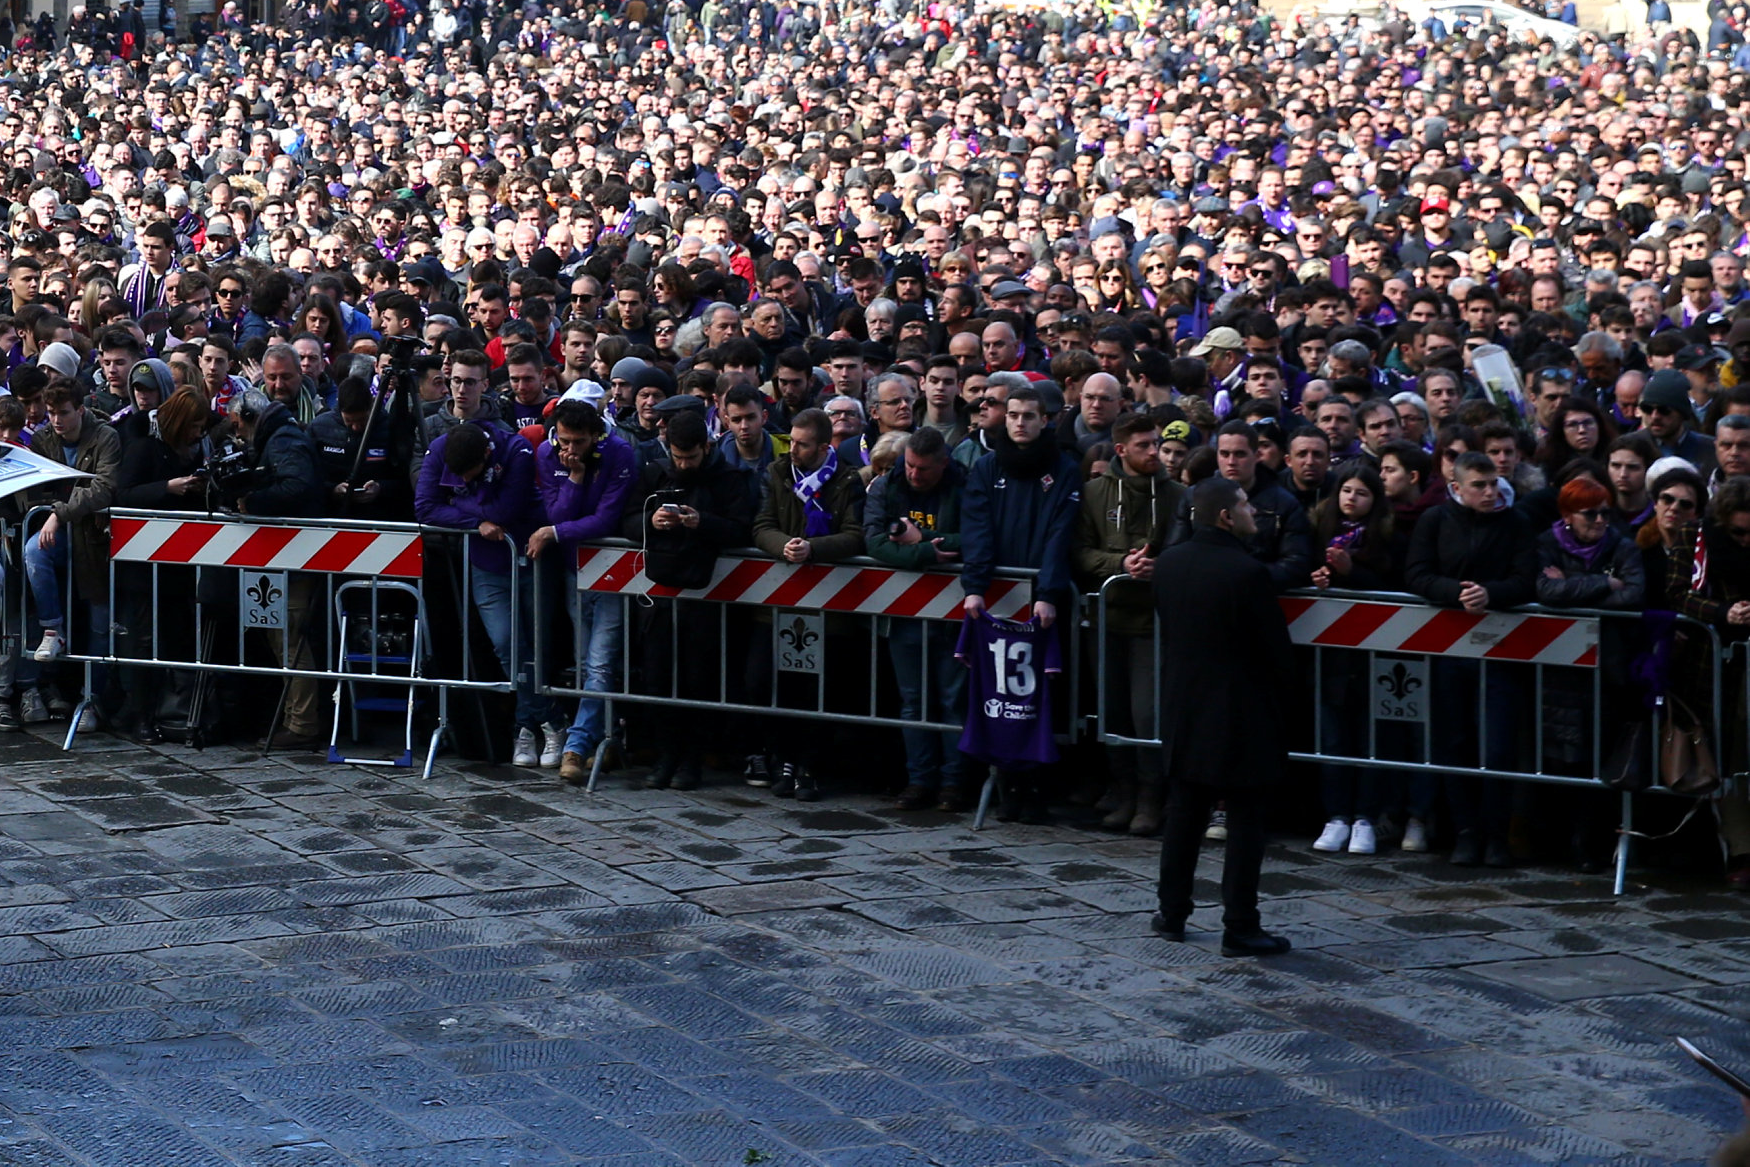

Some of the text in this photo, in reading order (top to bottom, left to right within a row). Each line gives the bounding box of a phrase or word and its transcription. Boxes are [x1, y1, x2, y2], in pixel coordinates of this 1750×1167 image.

[249, 609, 279, 625] SaS
[782, 652, 815, 669] SaS
[988, 638, 1036, 696] 13
[1004, 702, 1024, 712] Save
[1380, 699, 1419, 718] SaS
